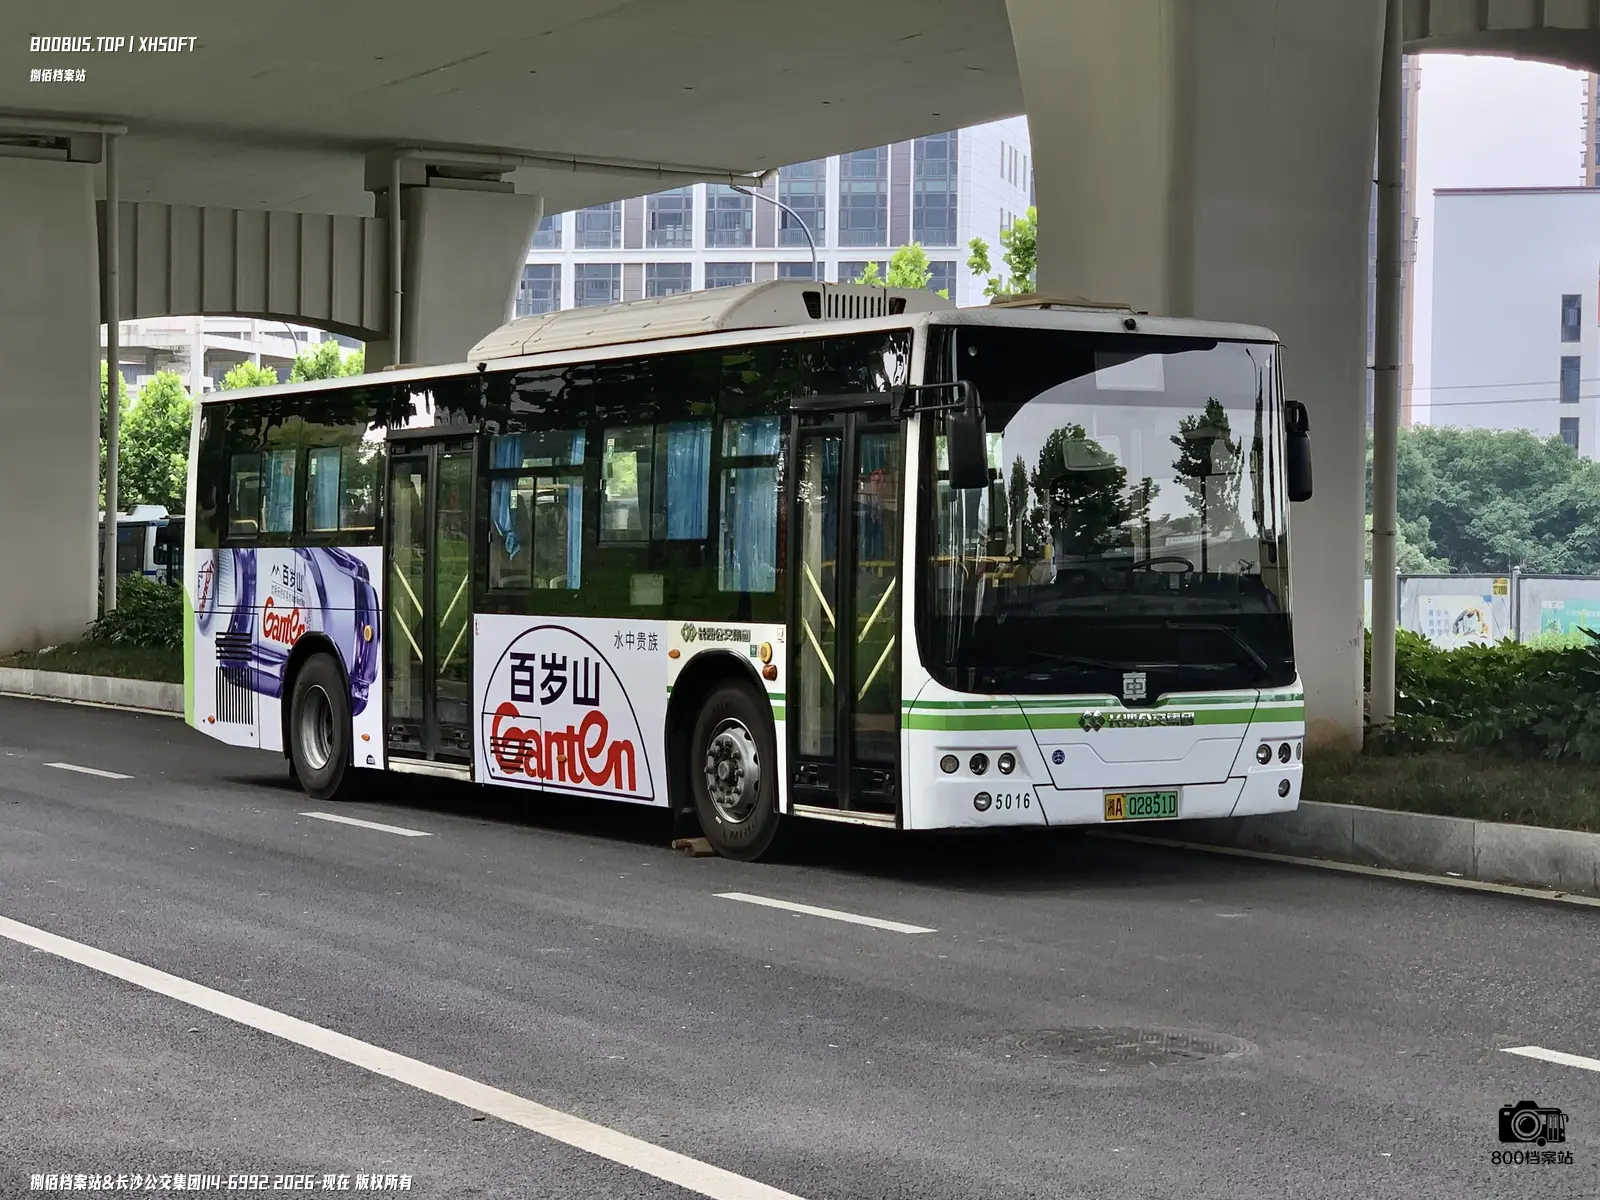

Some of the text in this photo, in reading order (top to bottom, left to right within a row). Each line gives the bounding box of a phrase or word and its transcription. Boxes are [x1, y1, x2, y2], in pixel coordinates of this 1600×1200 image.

[283, 564, 303, 592] 百岁山
[614, 630, 658, 651] 水中贵族
[510, 652, 600, 706] 百岁山
[491, 702, 637, 791] Ganten
[995, 793, 1030, 810] 5016
